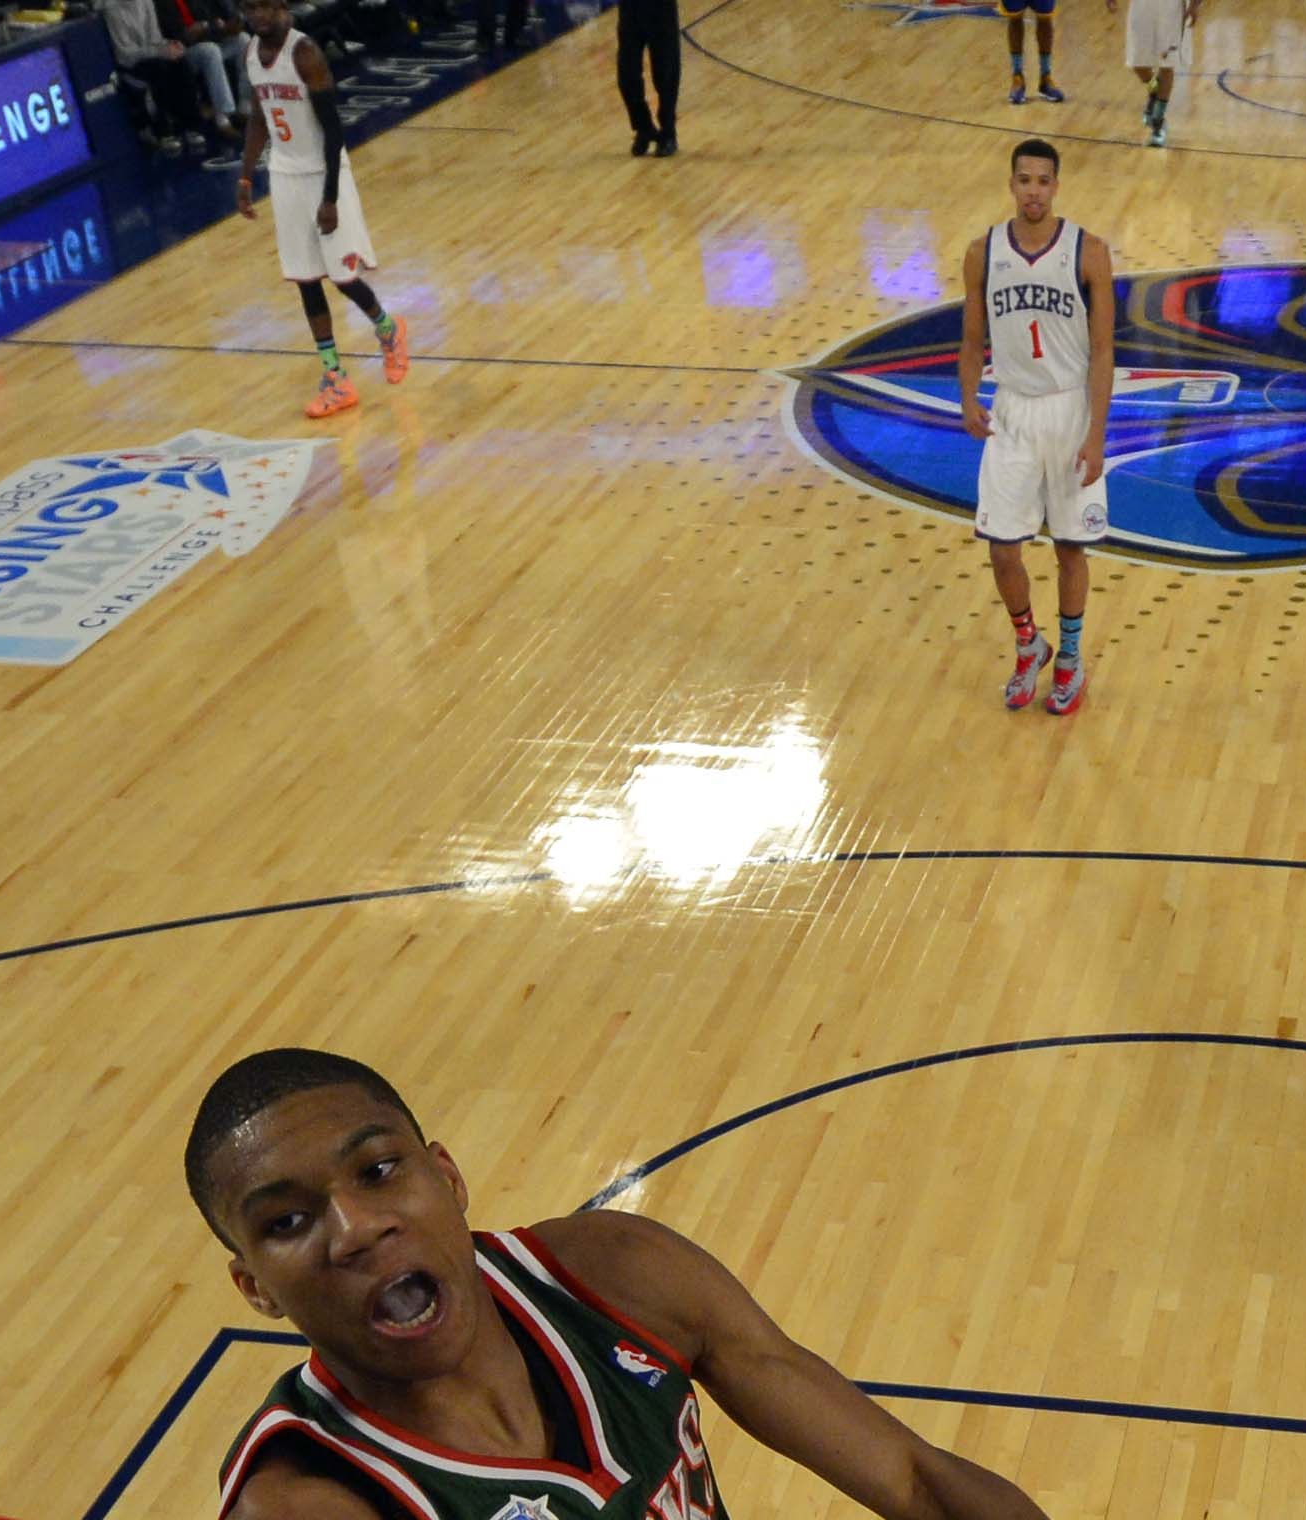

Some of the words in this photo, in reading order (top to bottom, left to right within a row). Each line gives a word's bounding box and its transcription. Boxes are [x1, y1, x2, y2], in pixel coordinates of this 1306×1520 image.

[271, 107, 293, 142] 5
[992, 283, 1075, 318] SIXERS
[1028, 319, 1044, 359] 1
[78, 528, 223, 629] CHALLENGE
